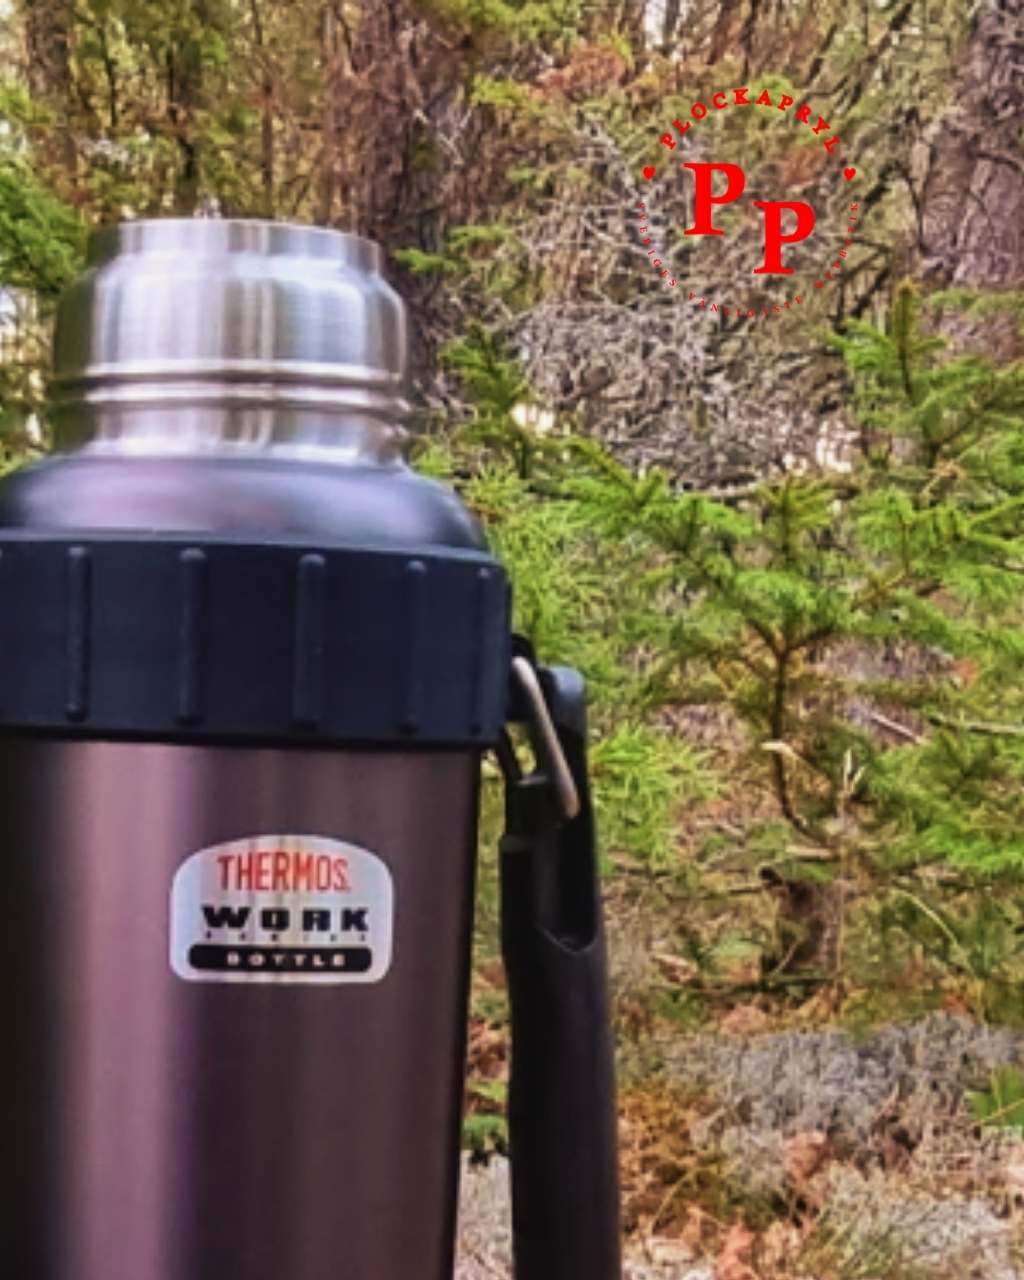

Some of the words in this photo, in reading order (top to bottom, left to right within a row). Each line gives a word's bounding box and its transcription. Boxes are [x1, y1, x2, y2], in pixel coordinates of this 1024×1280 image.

[217, 850, 349, 891] THERMOS
[202, 905, 368, 931] WORK
[227, 952, 346, 967] BOTTLE
